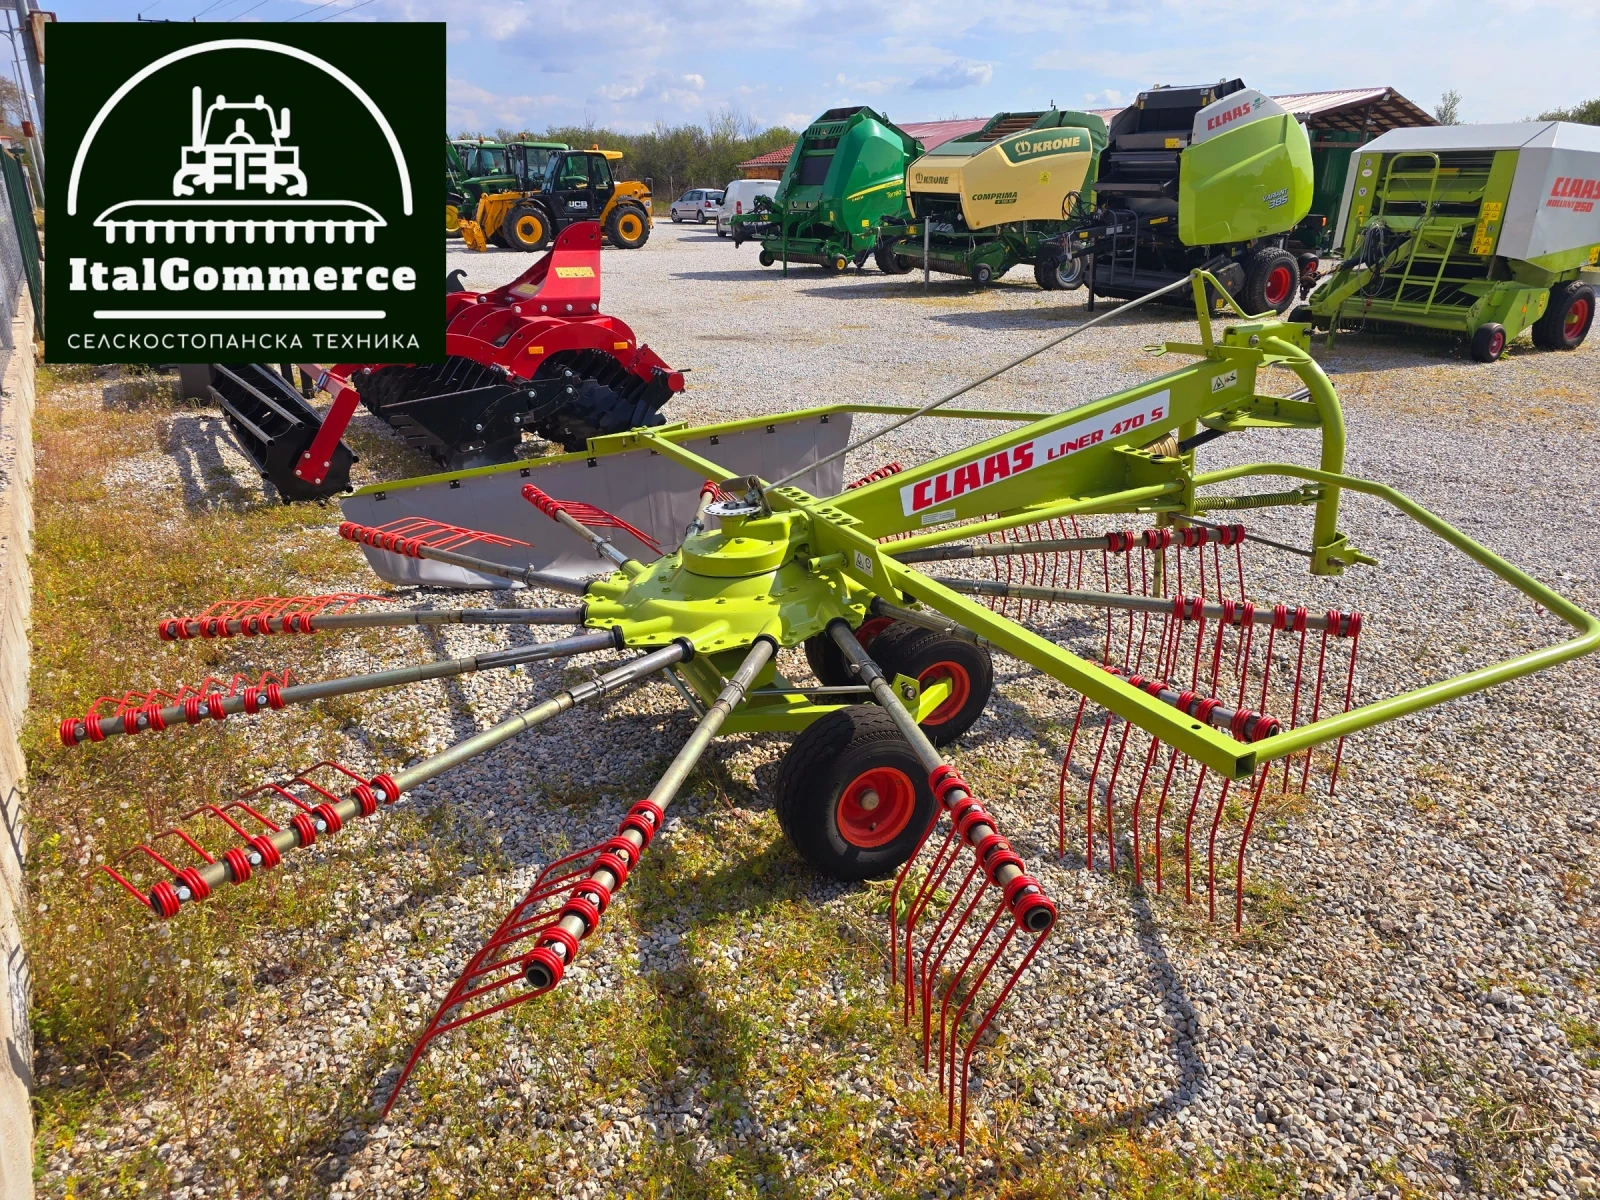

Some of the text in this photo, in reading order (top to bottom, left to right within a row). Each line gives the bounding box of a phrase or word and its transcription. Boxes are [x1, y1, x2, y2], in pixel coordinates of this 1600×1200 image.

[1207, 102, 1251, 131] CLAAS
[1032, 137, 1081, 154] KRONE
[972, 191, 1018, 201] COMPRIMA
[1262, 187, 1289, 202] VARIANT
[568, 200, 588, 208] JCB
[1545, 199, 1595, 213] ROLLANT 250
[912, 406, 1164, 512] CLAAS LINER 470 S
